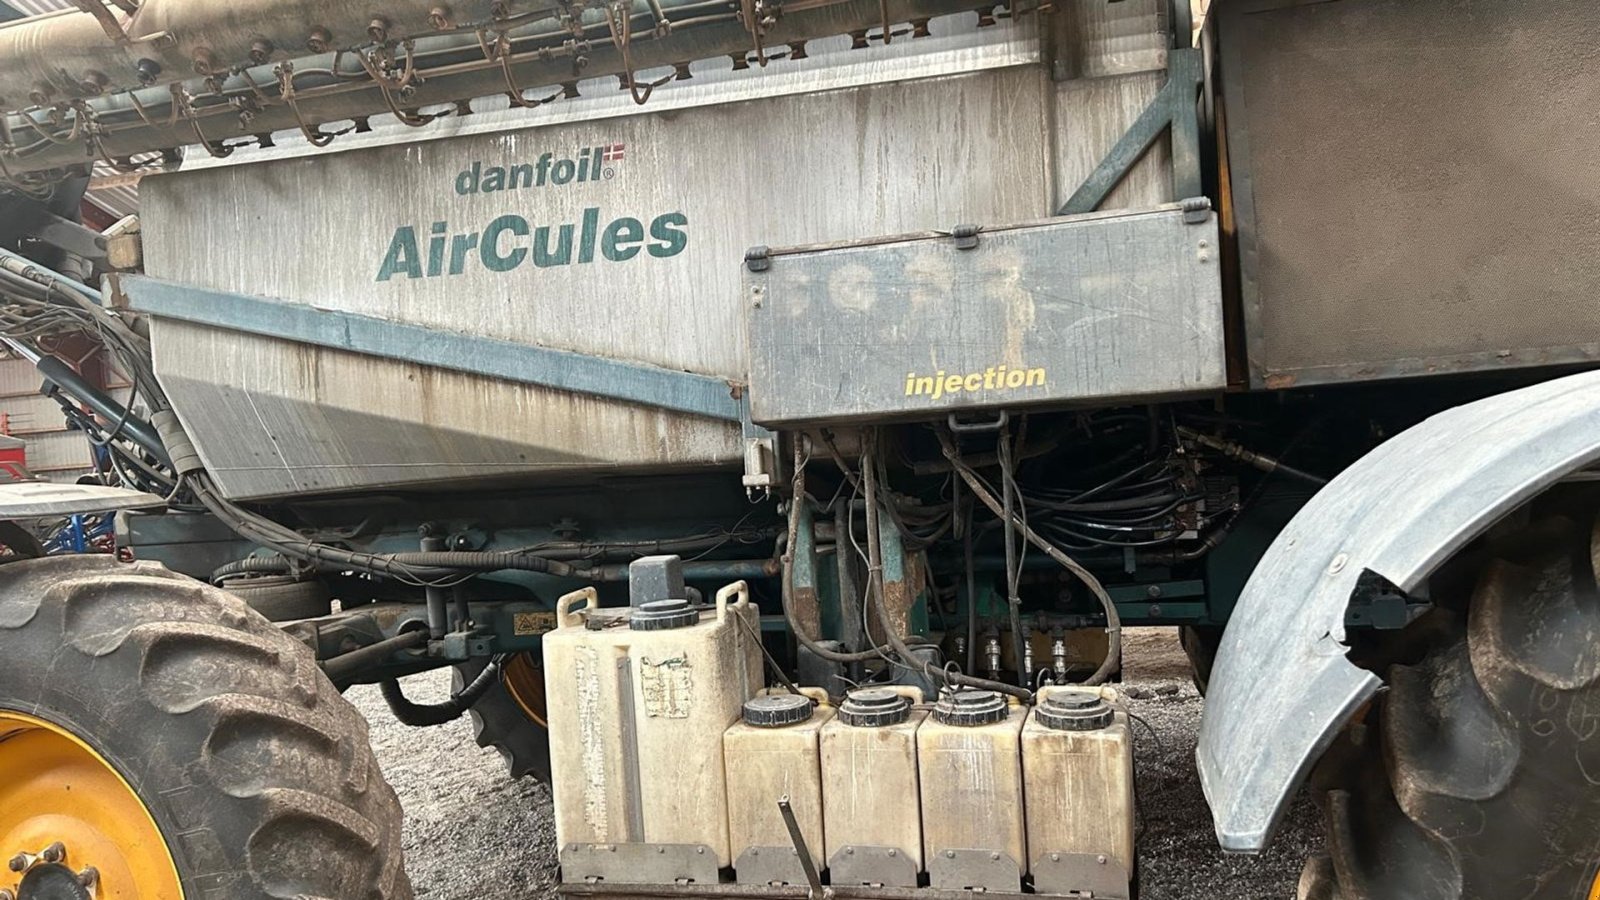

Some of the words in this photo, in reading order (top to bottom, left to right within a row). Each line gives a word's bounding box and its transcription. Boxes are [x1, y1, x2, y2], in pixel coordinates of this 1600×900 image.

[455, 146, 604, 195] danfoil
[375, 206, 689, 282] AirCules
[905, 365, 1046, 399] injection
